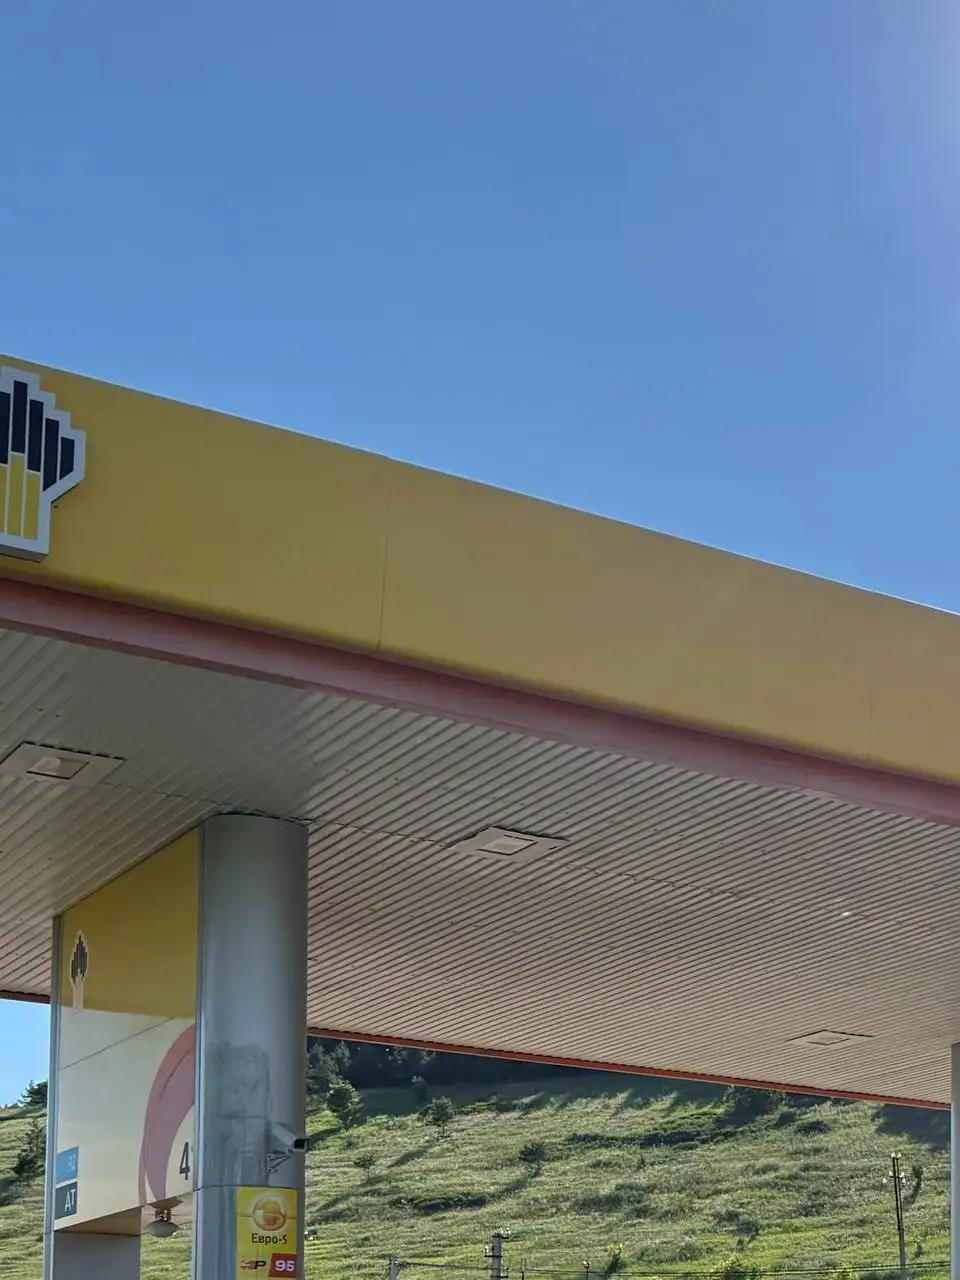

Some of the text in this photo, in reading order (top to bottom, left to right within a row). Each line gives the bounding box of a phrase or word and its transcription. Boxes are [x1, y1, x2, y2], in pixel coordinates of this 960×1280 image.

[179, 1141, 190, 1181] 4
[251, 1232, 288, 1247] Евро-5
[274, 1259, 296, 1272] 95
